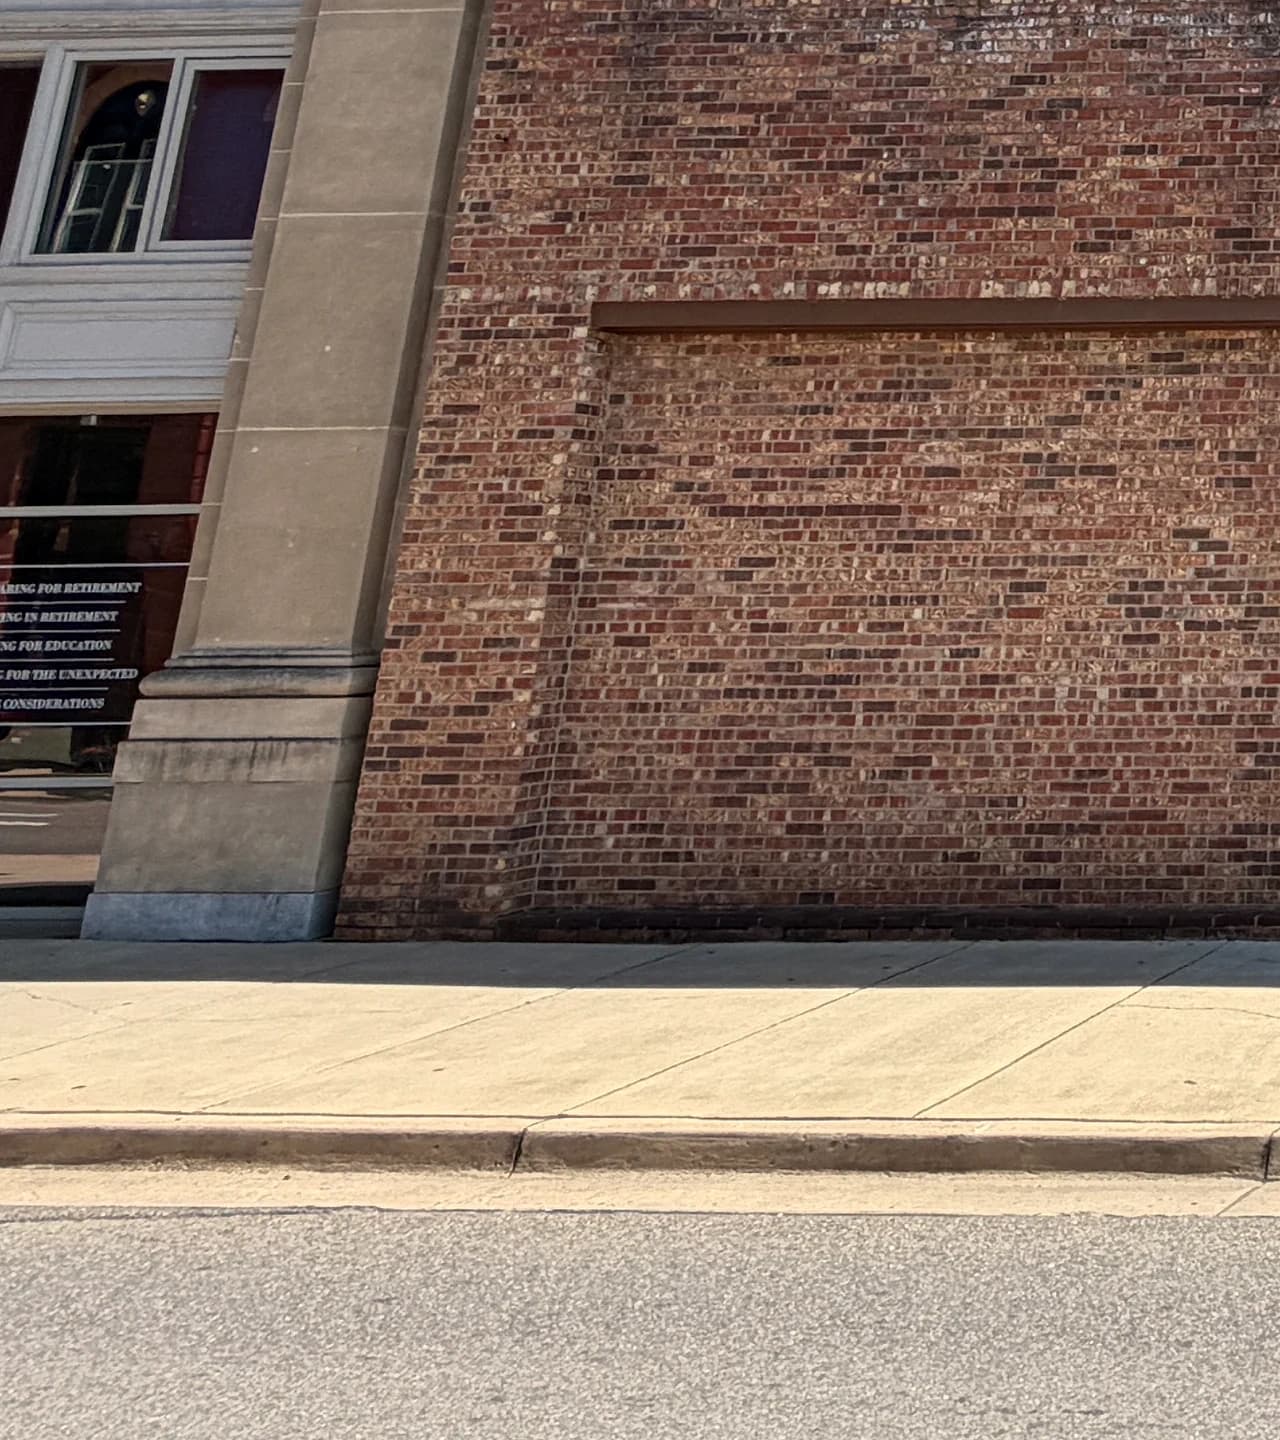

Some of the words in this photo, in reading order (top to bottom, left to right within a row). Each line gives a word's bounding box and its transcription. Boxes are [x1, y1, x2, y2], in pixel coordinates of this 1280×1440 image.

[38, 583, 62, 594] FOR
[63, 582, 142, 594] RETIREMENT
[40, 611, 119, 622] RETIREMENT
[18, 640, 43, 651] FOR
[44, 640, 113, 651] EDUCATION
[6, 669, 31, 680] FOR
[32, 669, 57, 680] THE
[58, 668, 139, 680] UNEXPECTED
[2, 698, 105, 709] CONSIDERATIONS
